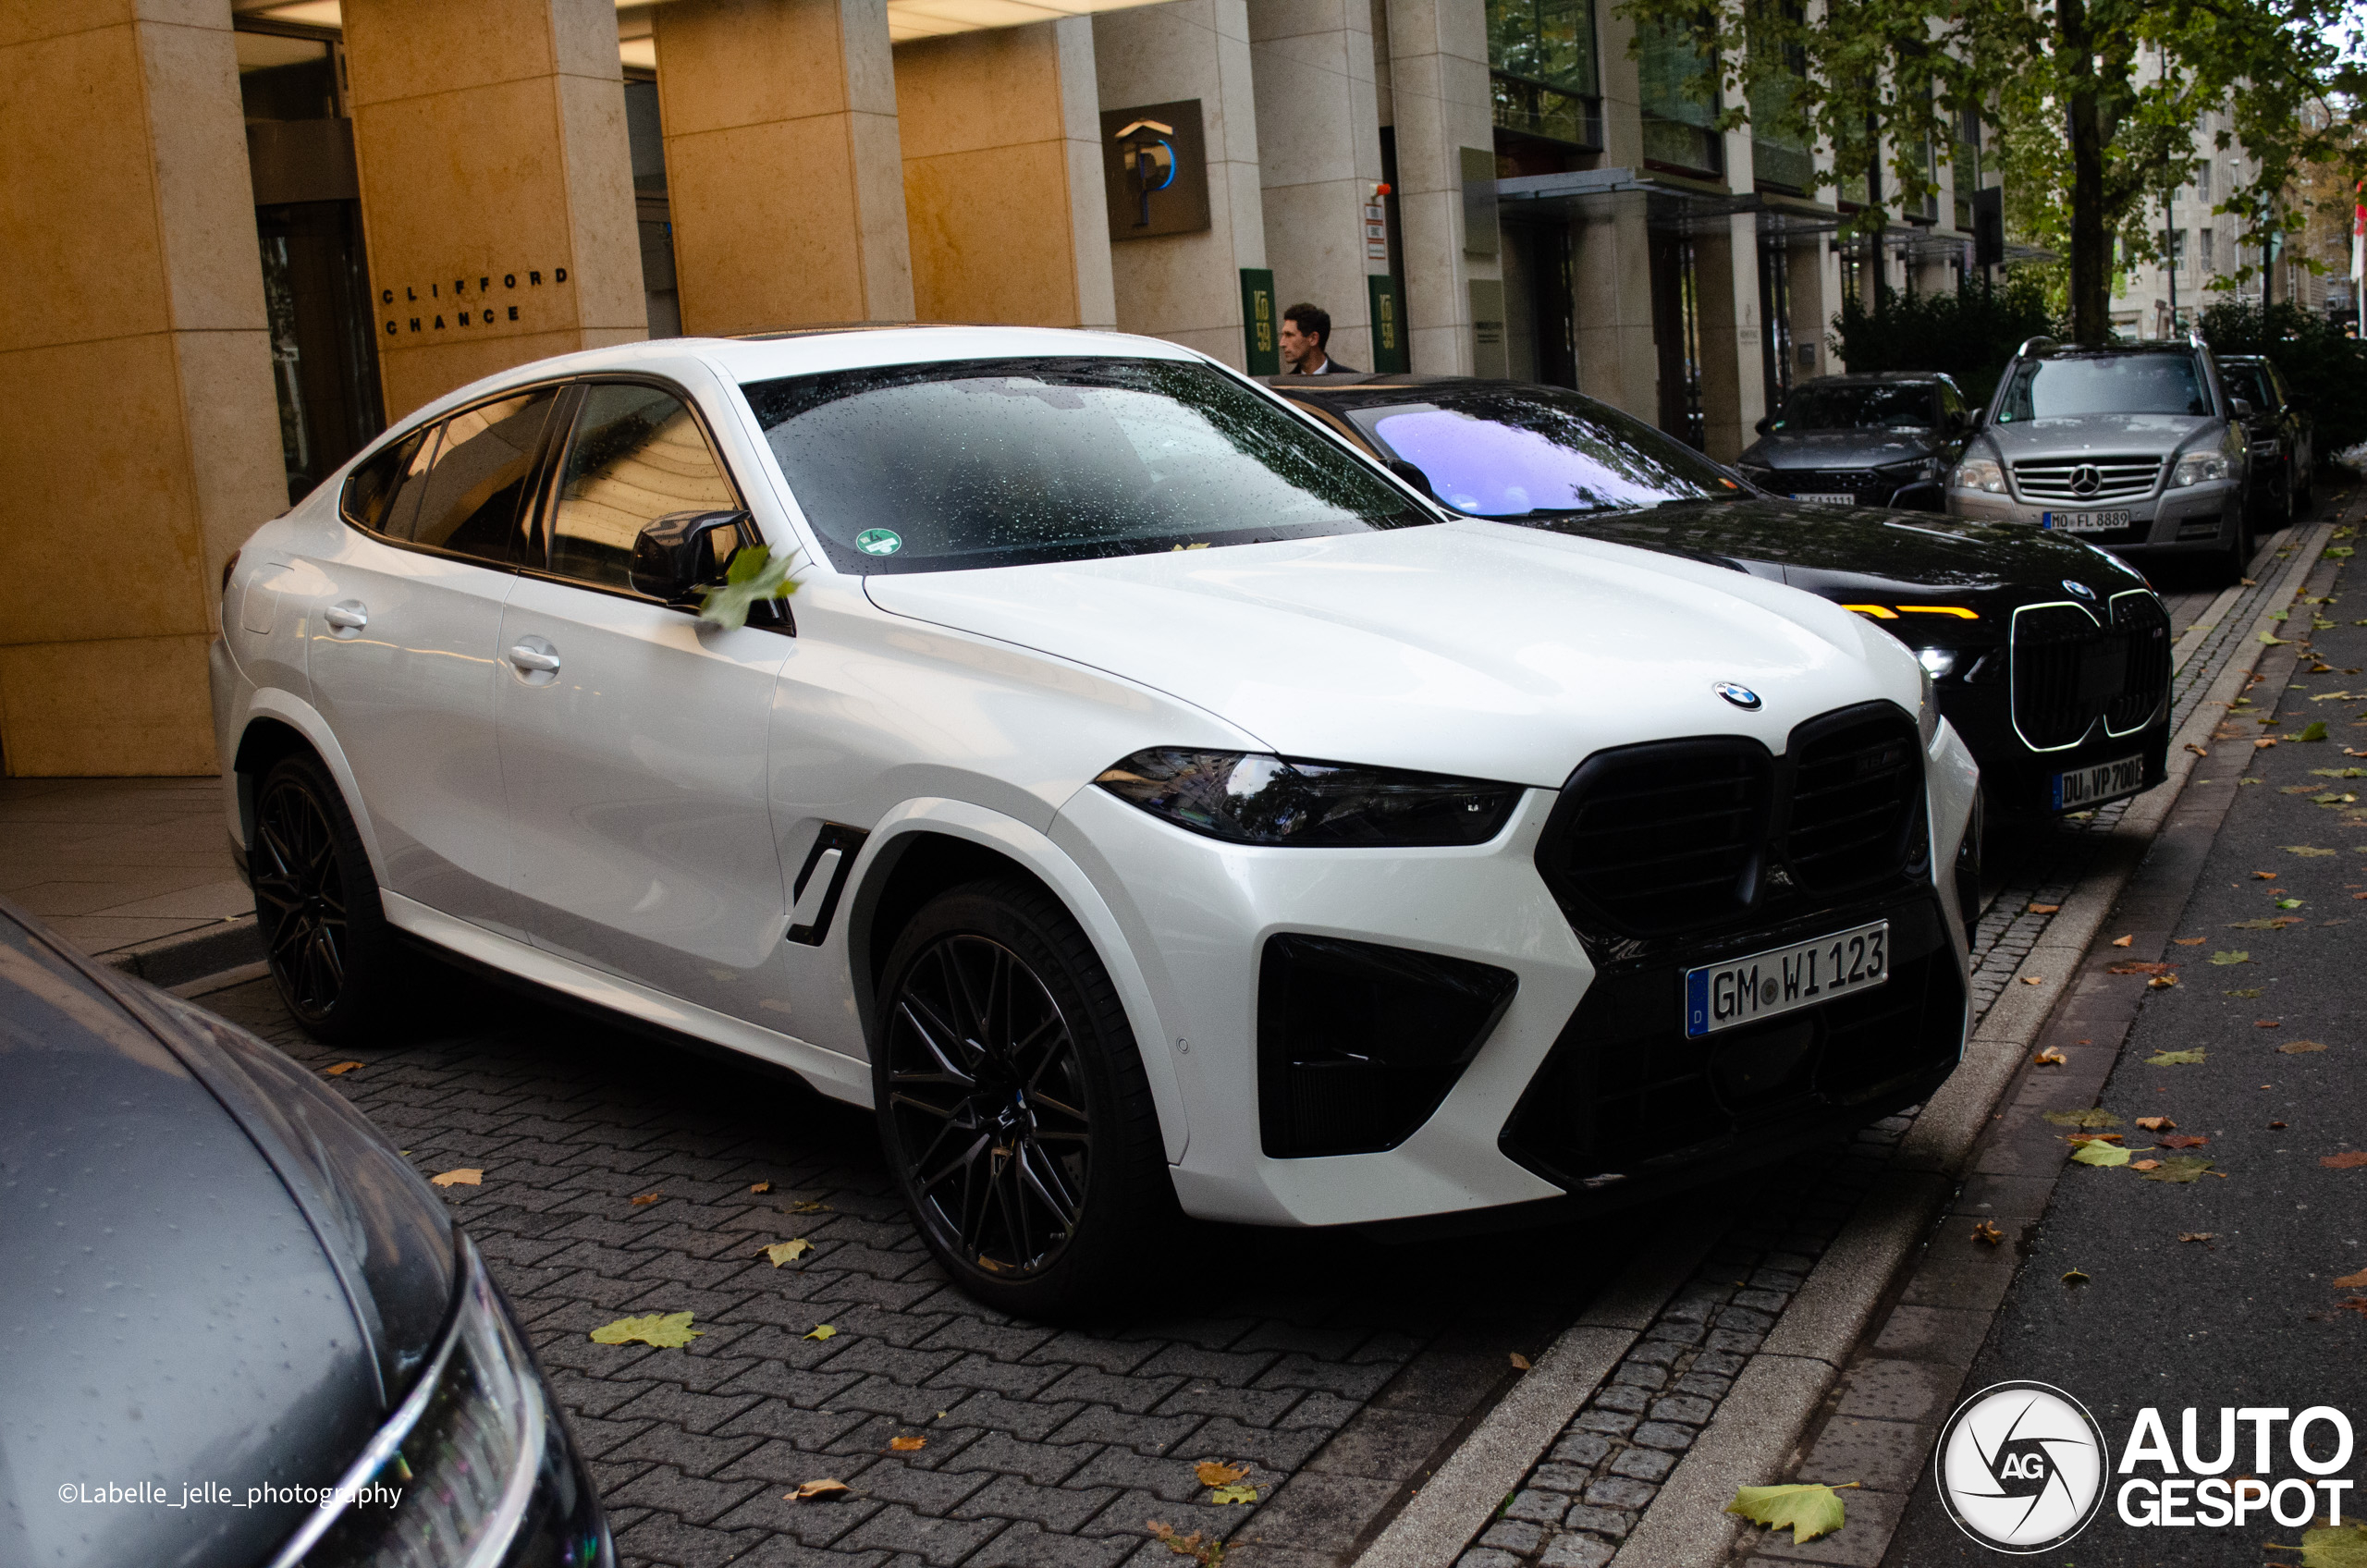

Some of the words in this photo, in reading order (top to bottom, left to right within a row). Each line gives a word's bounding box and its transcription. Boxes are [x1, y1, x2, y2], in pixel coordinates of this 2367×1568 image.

[382, 267, 568, 305] CLIFFORD
[386, 306, 520, 336] CHANCE
[1381, 323, 1395, 349] 59
[1256, 322, 1271, 352] 59
[2052, 514, 2068, 528] MO
[2077, 513, 2094, 527] FL
[2096, 512, 2128, 526] 8889
[2063, 773, 2083, 803] DU
[2091, 766, 2110, 797] VP
[1693, 1010, 1702, 1024] D
[1712, 964, 1758, 1020] GM
[1782, 949, 1820, 1002] WI
[1828, 929, 1884, 989] 123
